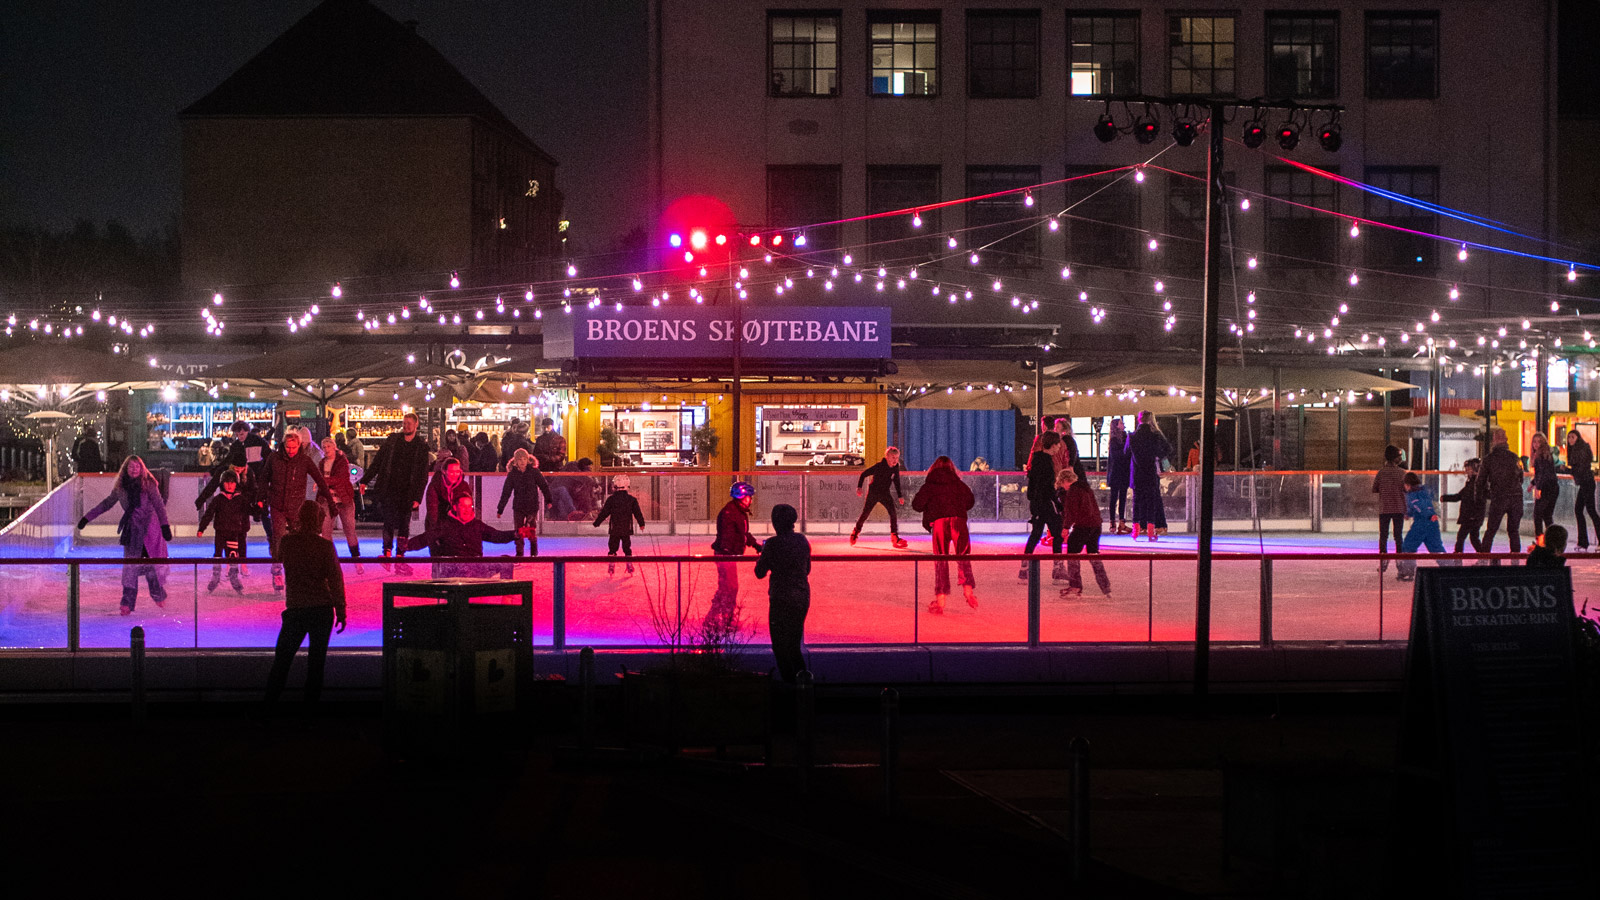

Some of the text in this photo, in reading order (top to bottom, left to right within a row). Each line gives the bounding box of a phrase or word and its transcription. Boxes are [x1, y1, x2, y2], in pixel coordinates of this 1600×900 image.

[586, 319, 696, 342] BROENS
[1450, 585, 1557, 611] BROENS
[1452, 612, 1560, 627] ICE SKATING RINK
